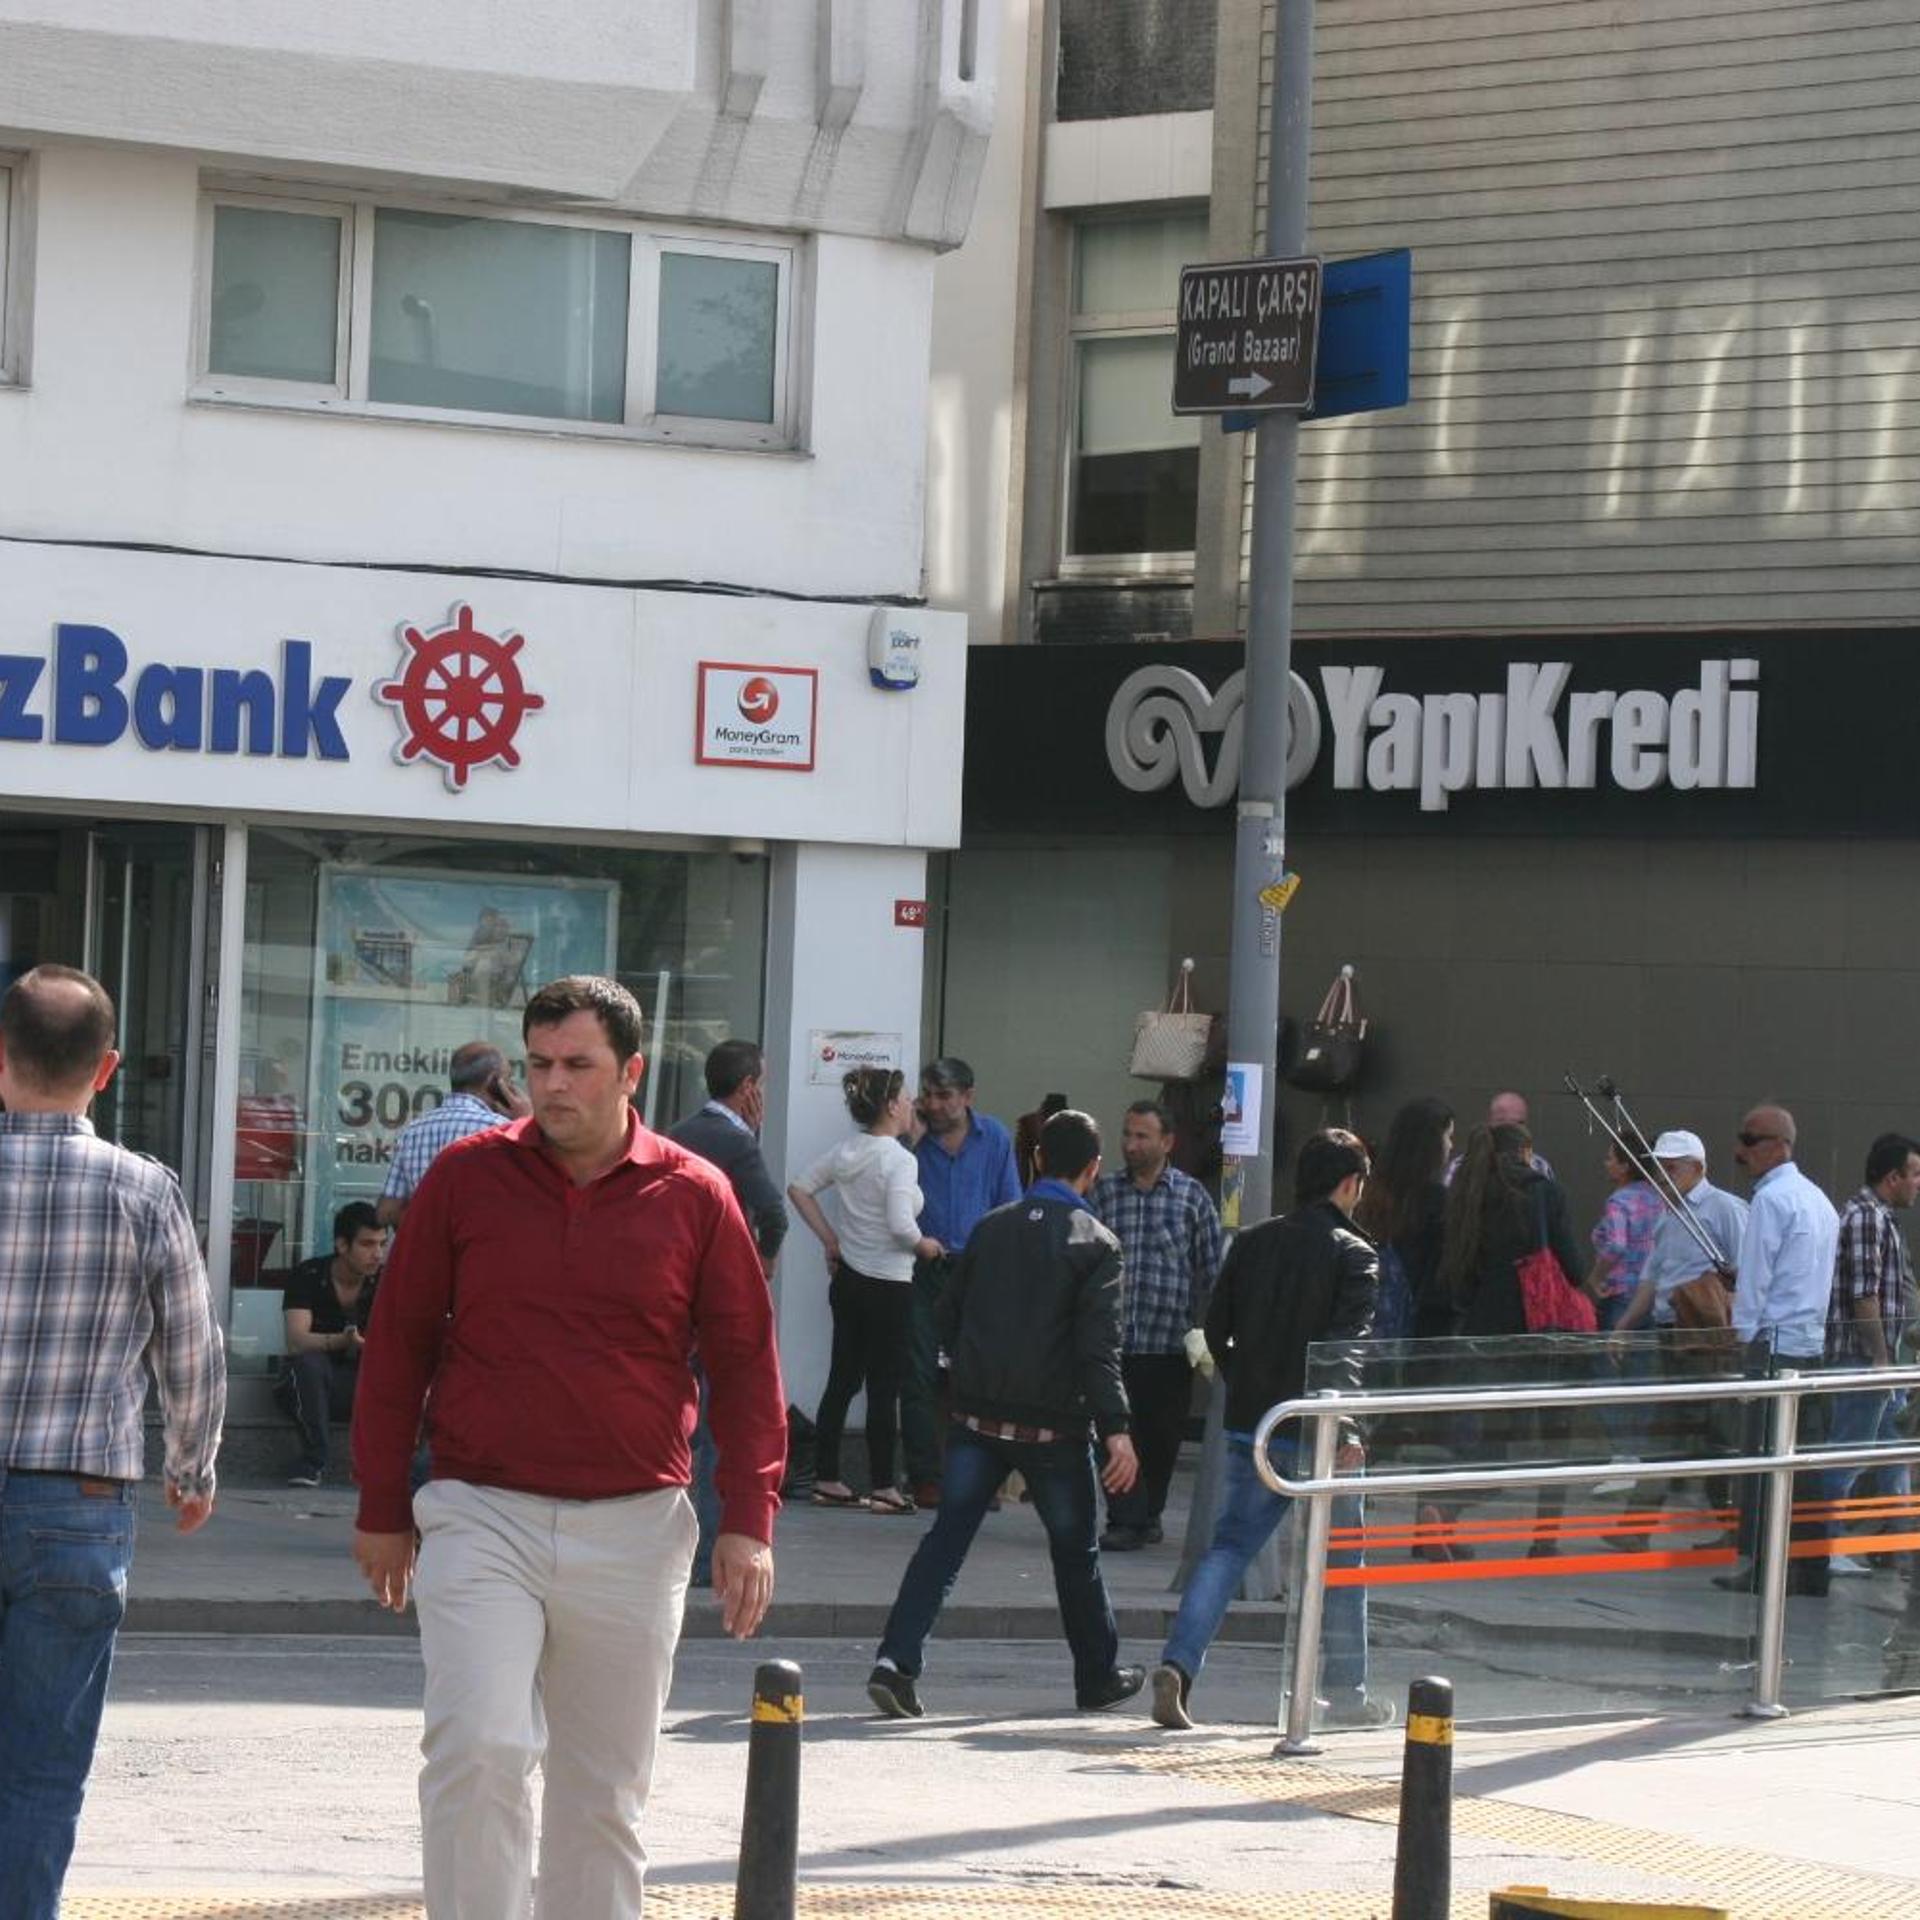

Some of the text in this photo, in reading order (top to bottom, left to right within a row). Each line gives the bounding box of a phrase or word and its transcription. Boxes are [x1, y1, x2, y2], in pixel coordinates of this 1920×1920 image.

[1182, 269, 1315, 323] KAPALI ÇARŞI
[1187, 330, 1301, 369] (Grand Bazaar)
[0, 623, 353, 762] zBank
[715, 727, 800, 746] MoneyGram
[1320, 658, 1759, 811] YapıKredi
[341, 1043, 455, 1076] Emekli
[335, 1137, 398, 1164] nak
